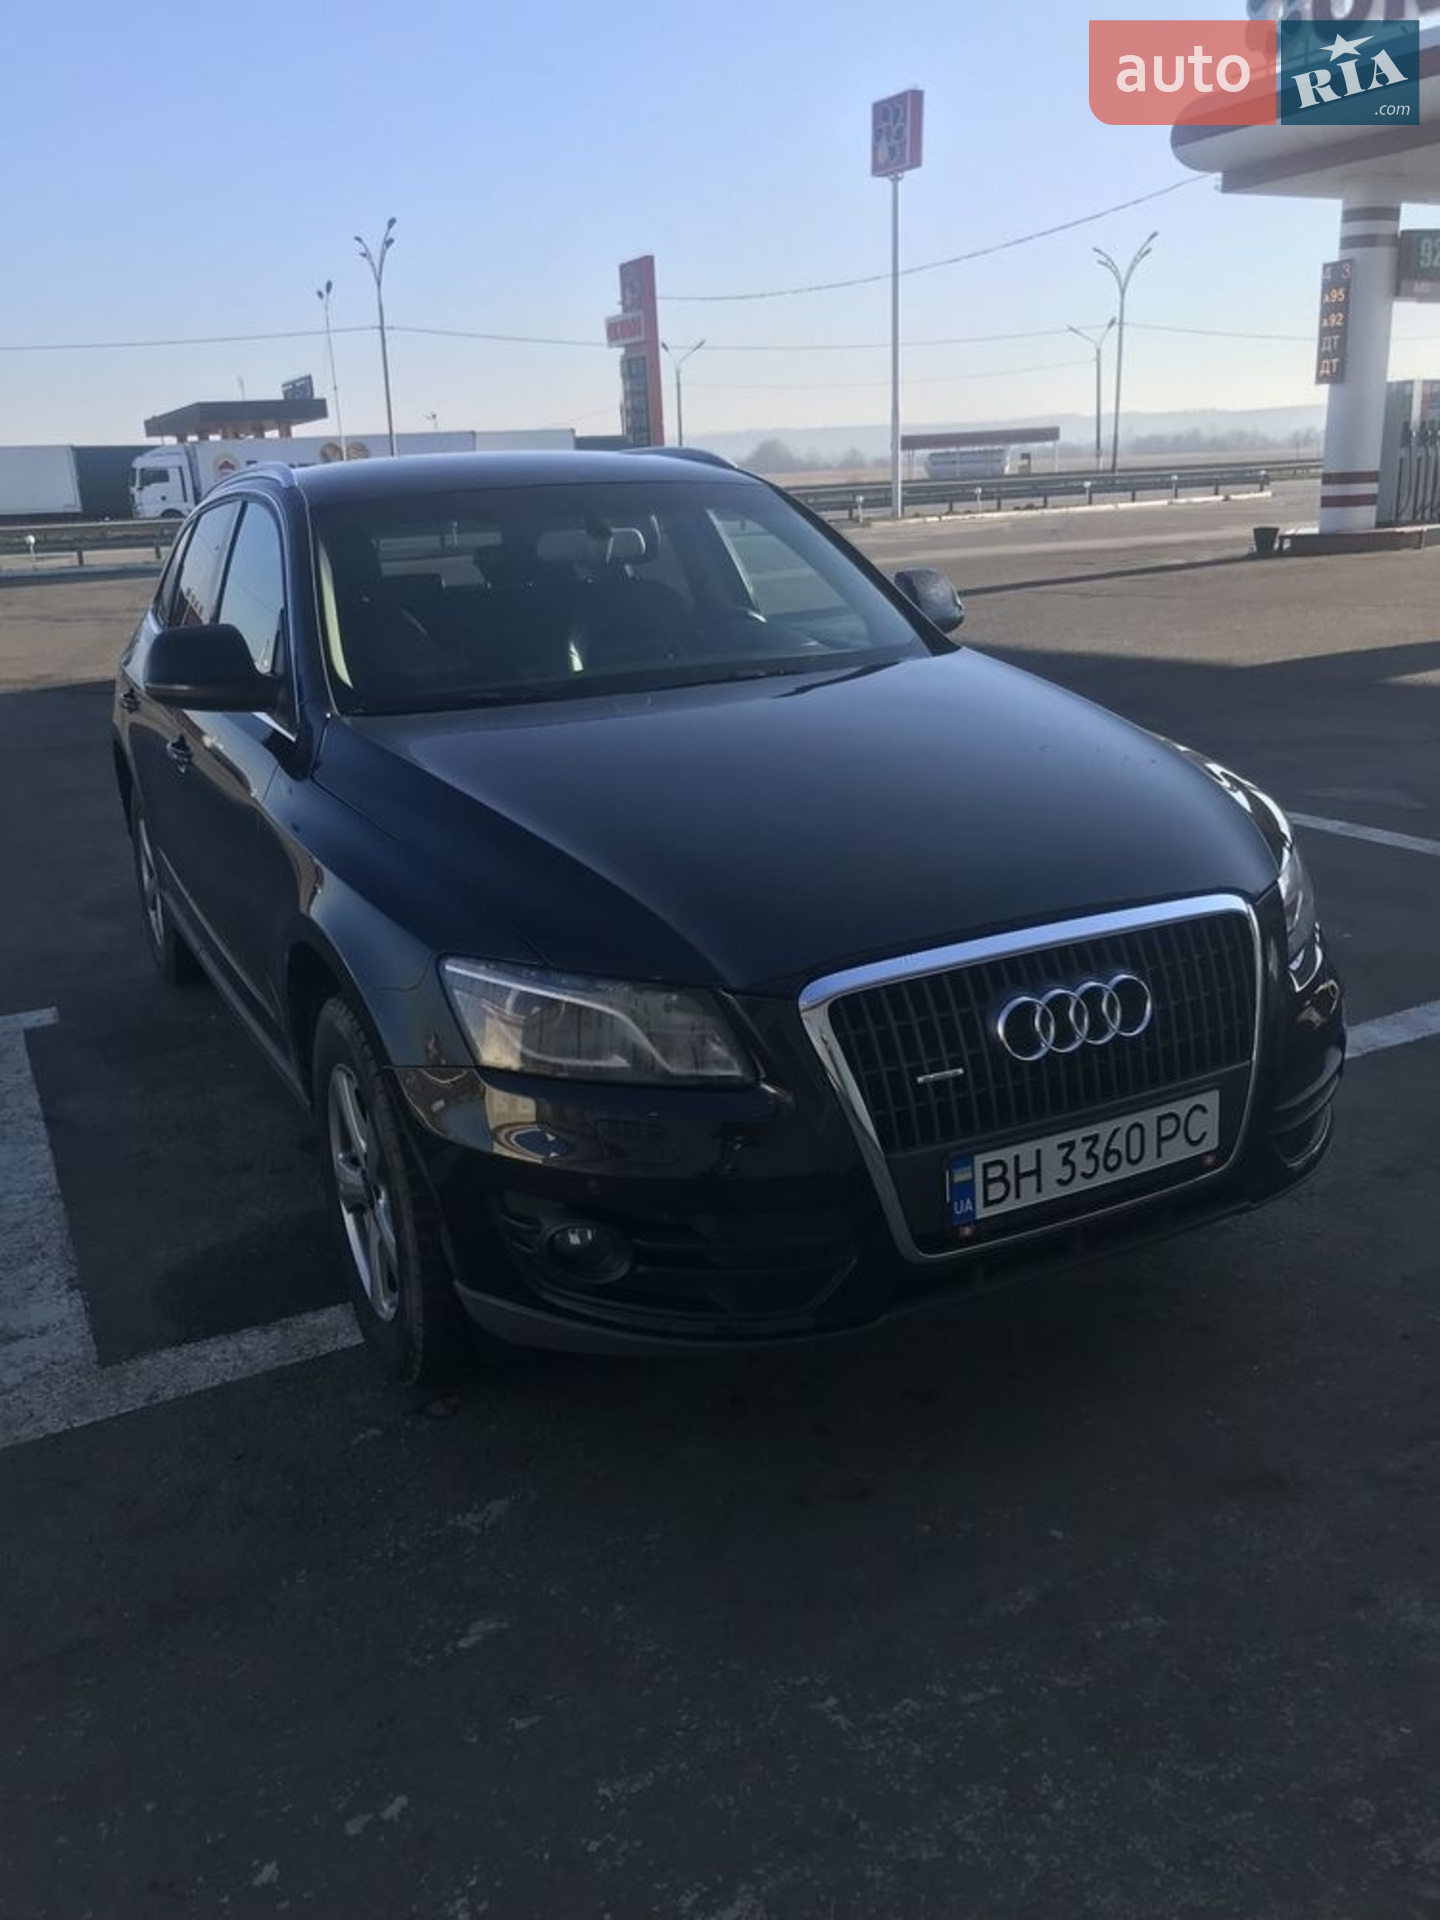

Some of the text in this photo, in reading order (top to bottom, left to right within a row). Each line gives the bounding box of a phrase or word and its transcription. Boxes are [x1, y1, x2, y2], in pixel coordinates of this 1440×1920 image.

[981, 1103, 1208, 1208] BH 3360 PC
[953, 1196, 974, 1214] UA
